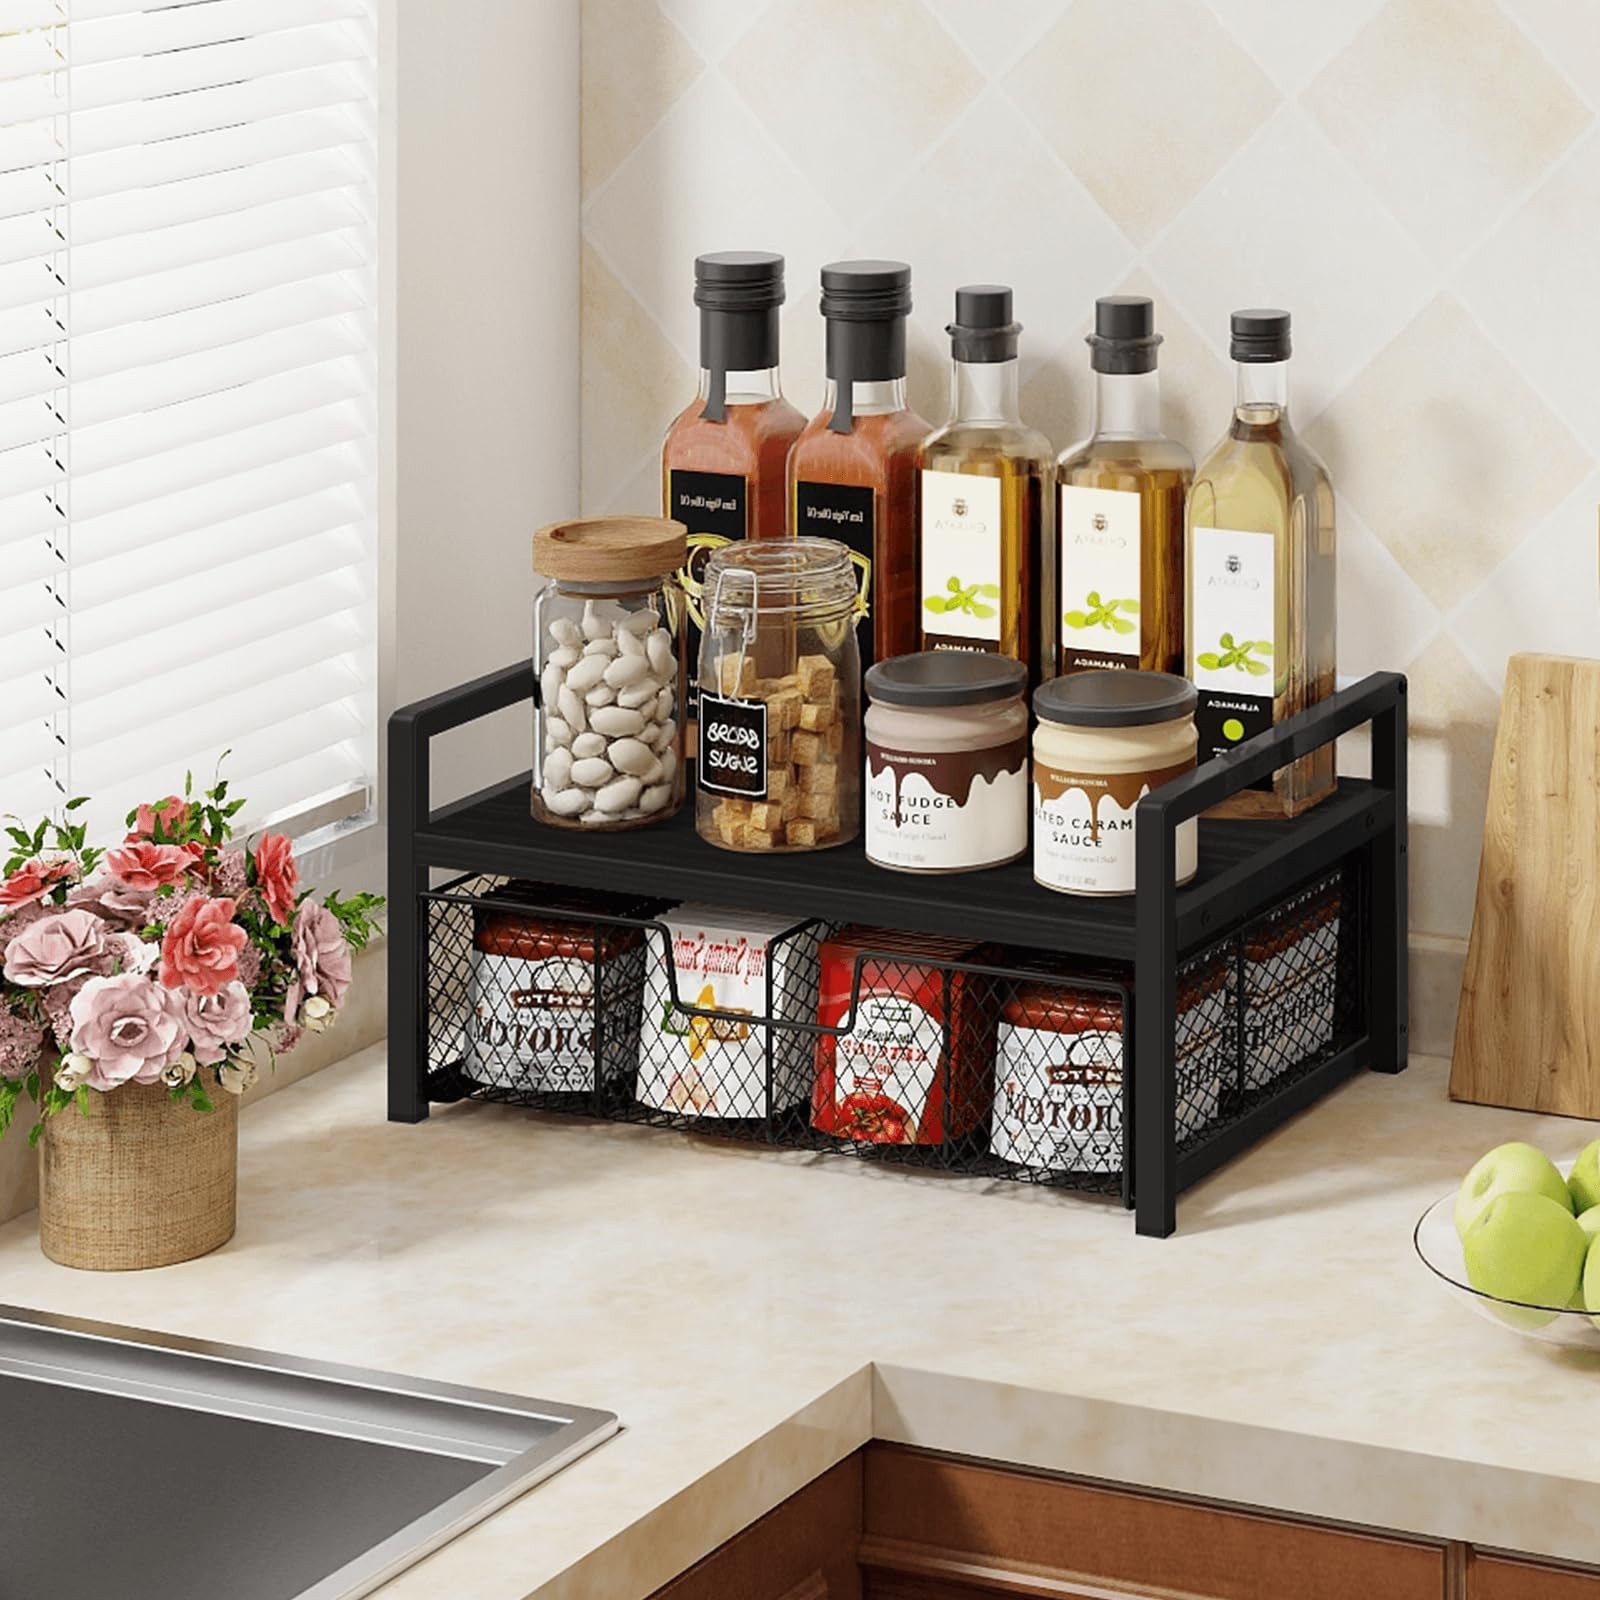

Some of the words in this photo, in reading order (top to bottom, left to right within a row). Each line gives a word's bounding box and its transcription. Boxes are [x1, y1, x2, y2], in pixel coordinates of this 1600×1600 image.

[870, 787, 892, 804] HOT
[898, 795, 954, 809] FUDGE
[881, 808, 931, 825] SAUCE
[1071, 818, 1133, 831] CARAM
[1051, 830, 1103, 848] SAUCE
